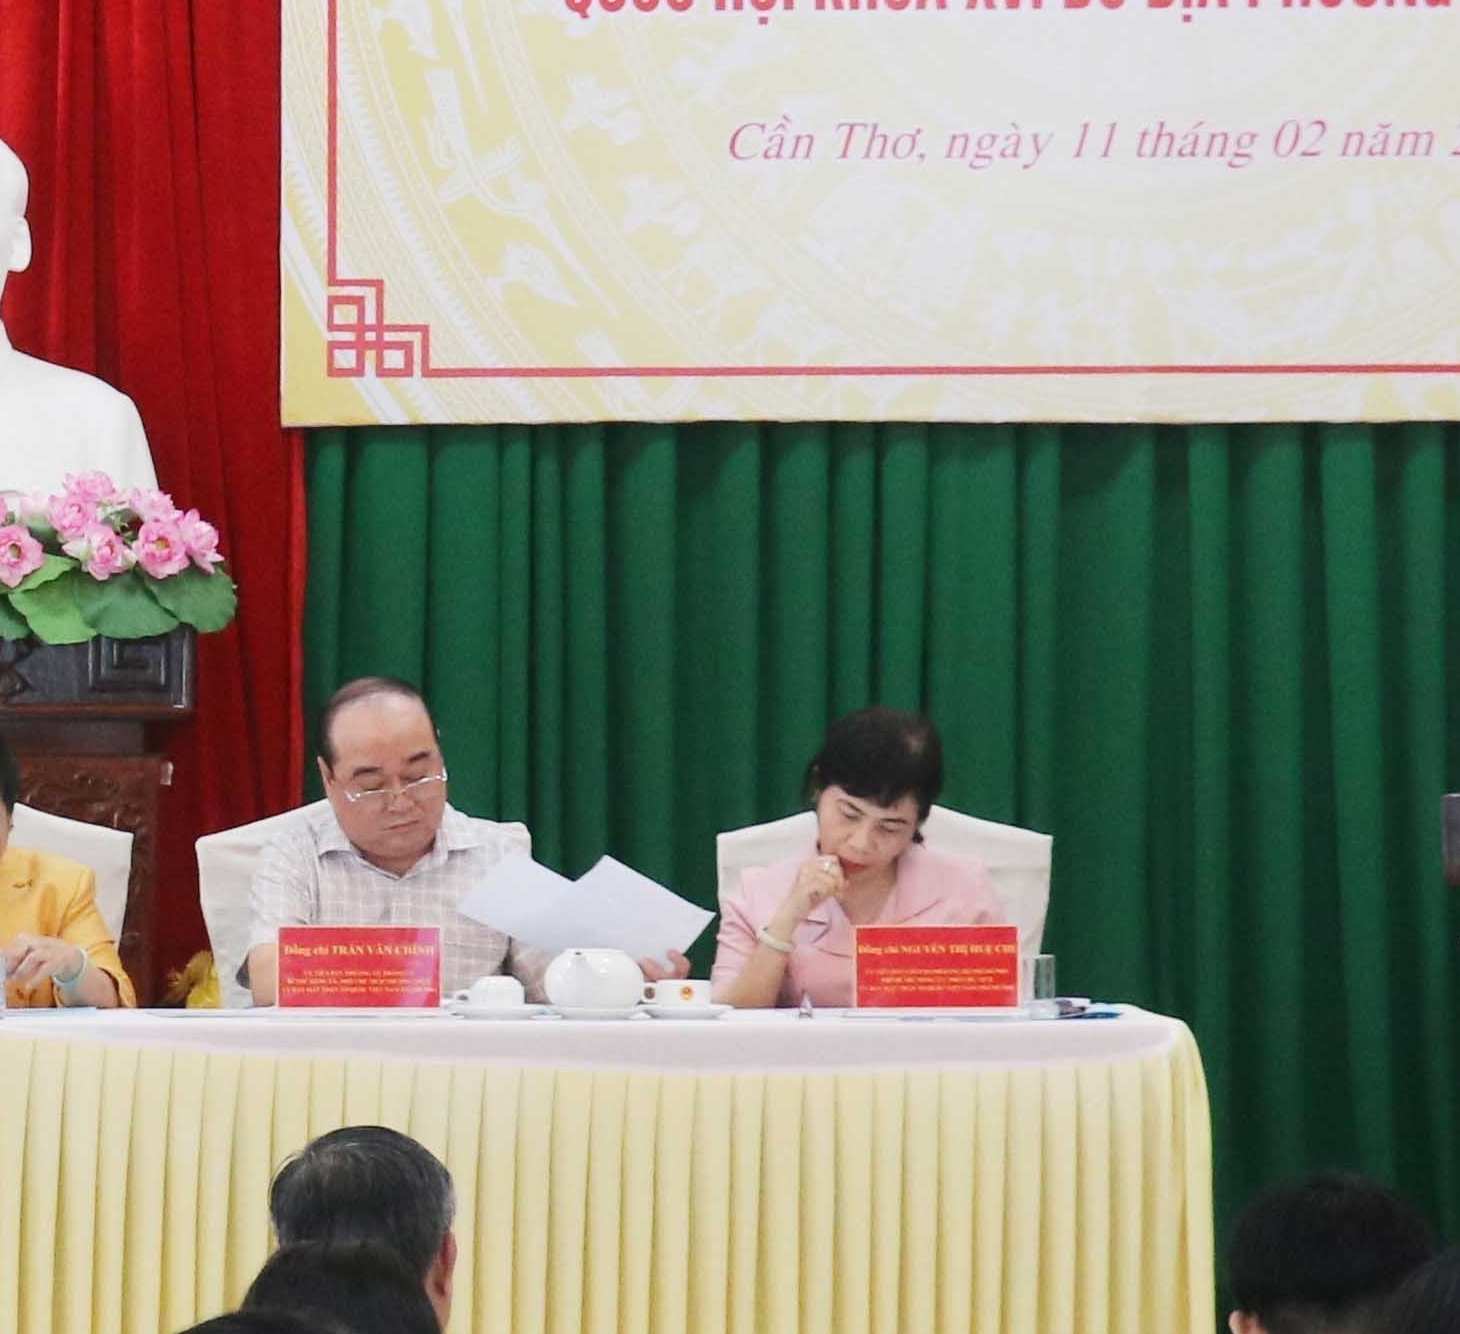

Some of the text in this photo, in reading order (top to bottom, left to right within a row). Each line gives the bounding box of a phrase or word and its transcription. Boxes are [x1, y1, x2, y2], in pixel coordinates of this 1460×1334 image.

[728, 115, 815, 161] Cần
[835, 122, 927, 164] Thơ,
[944, 123, 1055, 170] ngày
[1072, 121, 1118, 159] 11
[1135, 120, 1260, 168] tháng
[1272, 119, 1329, 158] 02
[1338, 122, 1436, 157] năm
